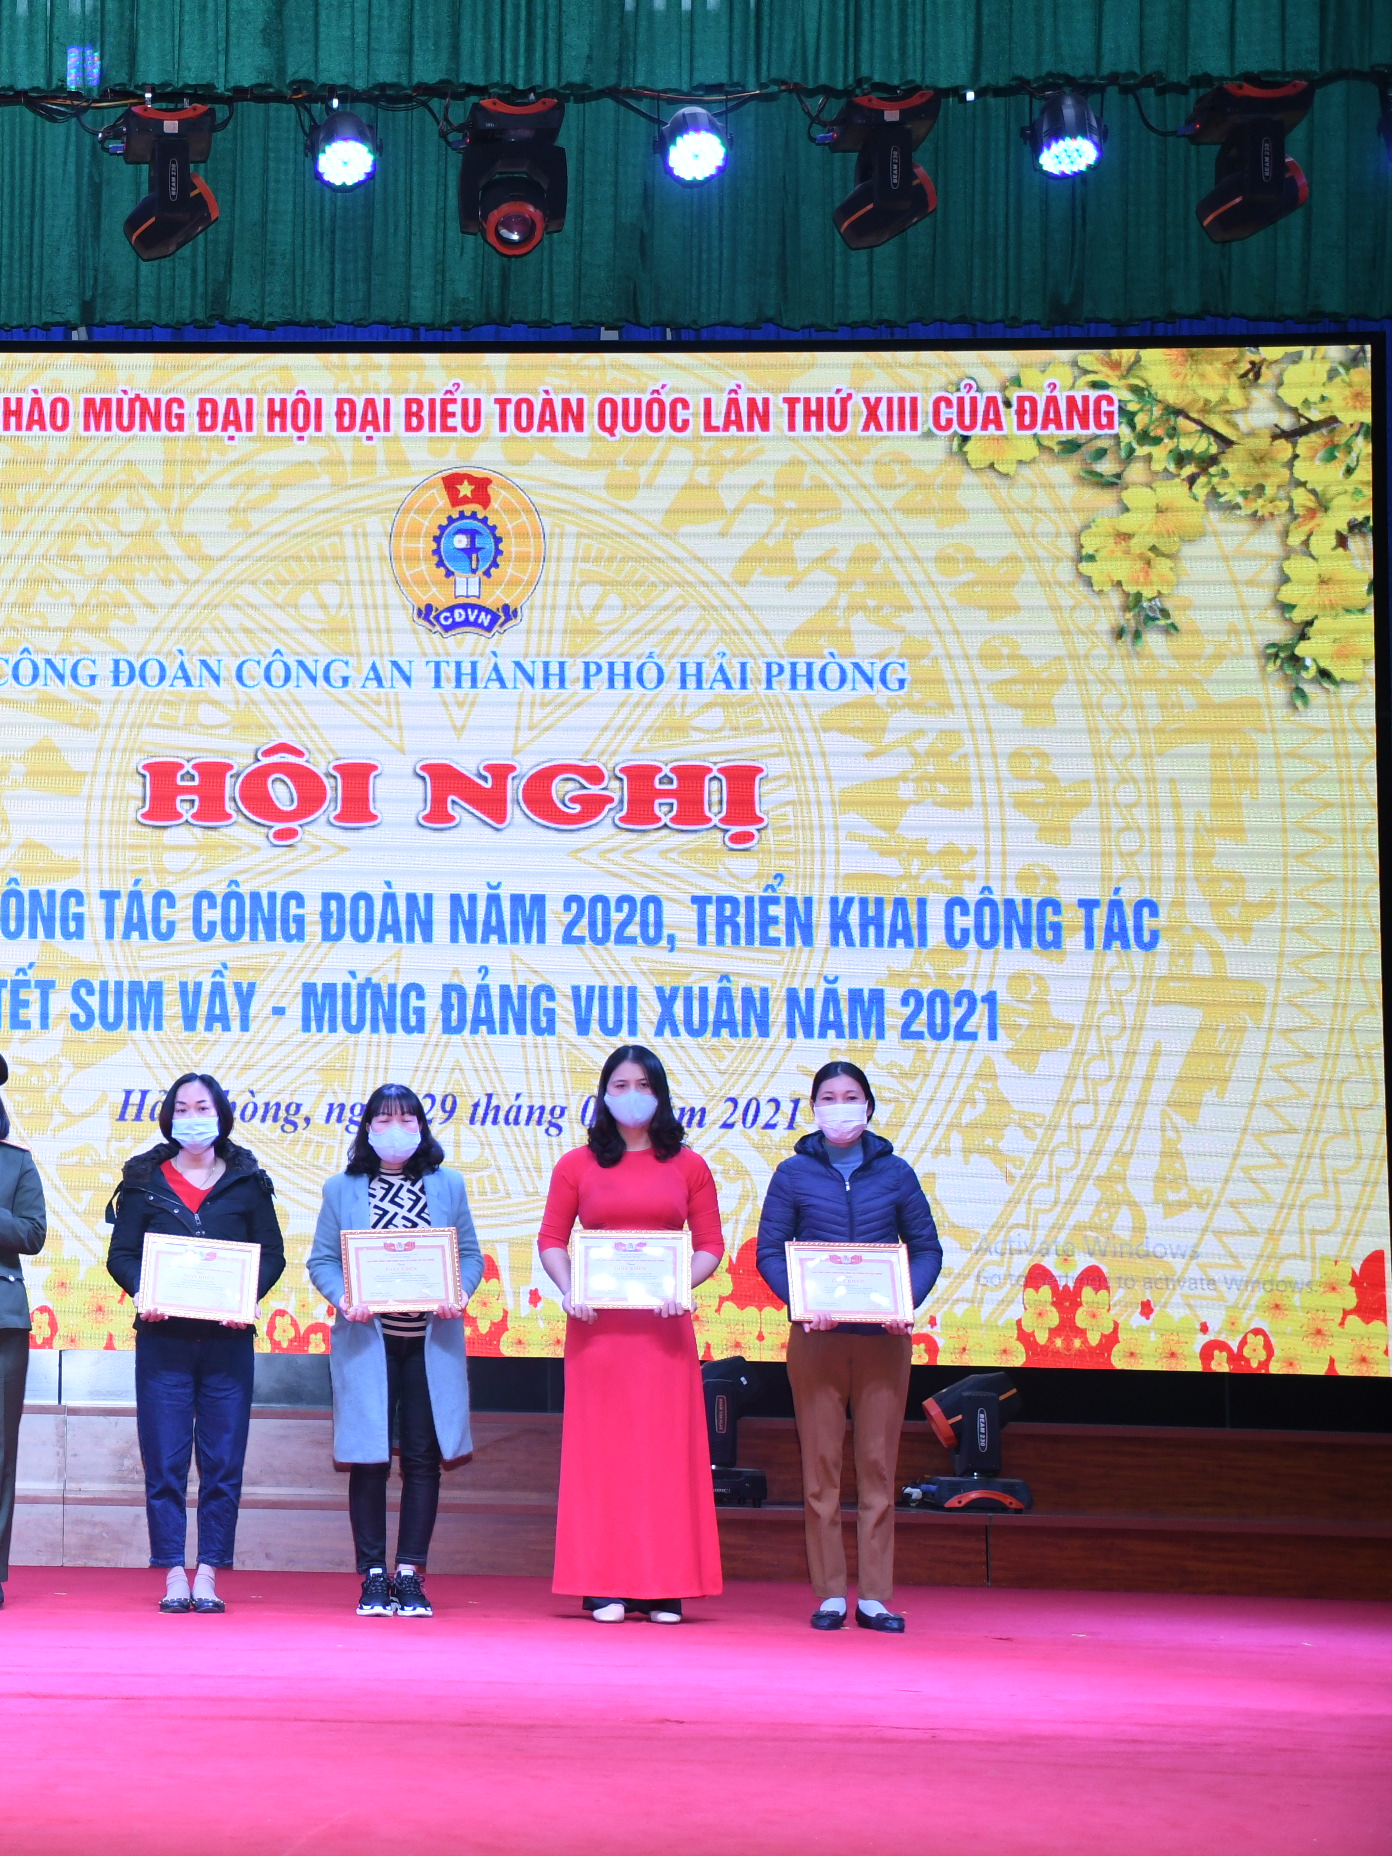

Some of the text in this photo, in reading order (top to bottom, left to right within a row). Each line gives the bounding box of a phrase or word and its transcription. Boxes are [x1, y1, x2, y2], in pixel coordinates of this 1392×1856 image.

[83, 389, 184, 432] MỪNG
[197, 398, 253, 440] ĐẠI
[267, 389, 322, 440] HỘI
[335, 398, 390, 440] ĐẠI
[405, 383, 482, 433] BIỂU
[494, 389, 584, 432] TOÀN
[598, 386, 690, 436] QUỐC
[703, 386, 771, 432] LẦN
[783, 389, 852, 432] THỨ
[863, 397, 919, 431] XIII
[933, 382, 1003, 432] CỦA
[1016, 382, 1115, 431] ĐẢNG
[110, 648, 222, 689] ĐOÀN
[234, 648, 352, 690] CÔNG
[361, 659, 415, 690] AN
[427, 649, 569, 691] THÀNH
[580, 647, 668, 692] PHỐ
[677, 648, 751, 692] HẢI
[763, 650, 909, 694] PHÒNG
[140, 741, 768, 848] HỘI NGHỊ
[99, 878, 176, 942] TÁC
[192, 879, 306, 943] CÔNG
[319, 880, 434, 944] ĐOÀN
[449, 881, 547, 946] NĂM
[561, 893, 677, 953] 2020,
[690, 872, 814, 948] TRIỂN
[828, 895, 929, 950] KHAI
[944, 885, 1063, 951] CÔNG
[1077, 886, 1161, 952] TÁC
[69, 978, 164, 1032] SUM
[178, 962, 257, 1033] VẦY
[271, 1005, 286, 1017] -
[301, 970, 426, 1036] MỪNG
[440, 965, 557, 1037] ĐẢNG
[571, 984, 639, 1038] VUI
[653, 974, 771, 1039] XUÂN
[785, 975, 886, 1041] NĂM
[900, 988, 999, 1042] 2021
[116, 1088, 164, 1123] Hả
[226, 1089, 310, 1133] hòng,
[325, 1101, 361, 1133] ng
[469, 1093, 568, 1137] tháng
[719, 1096, 800, 1131] 2021
[974, 1234, 1201, 1260] Activate Windows
[977, 1268, 1001, 1287] Go
[1009, 1270, 1028, 1287] to
[1035, 1269, 1108, 1293] Settings
[1117, 1274, 1136, 1289] to
[1142, 1275, 1217, 1291] activate
